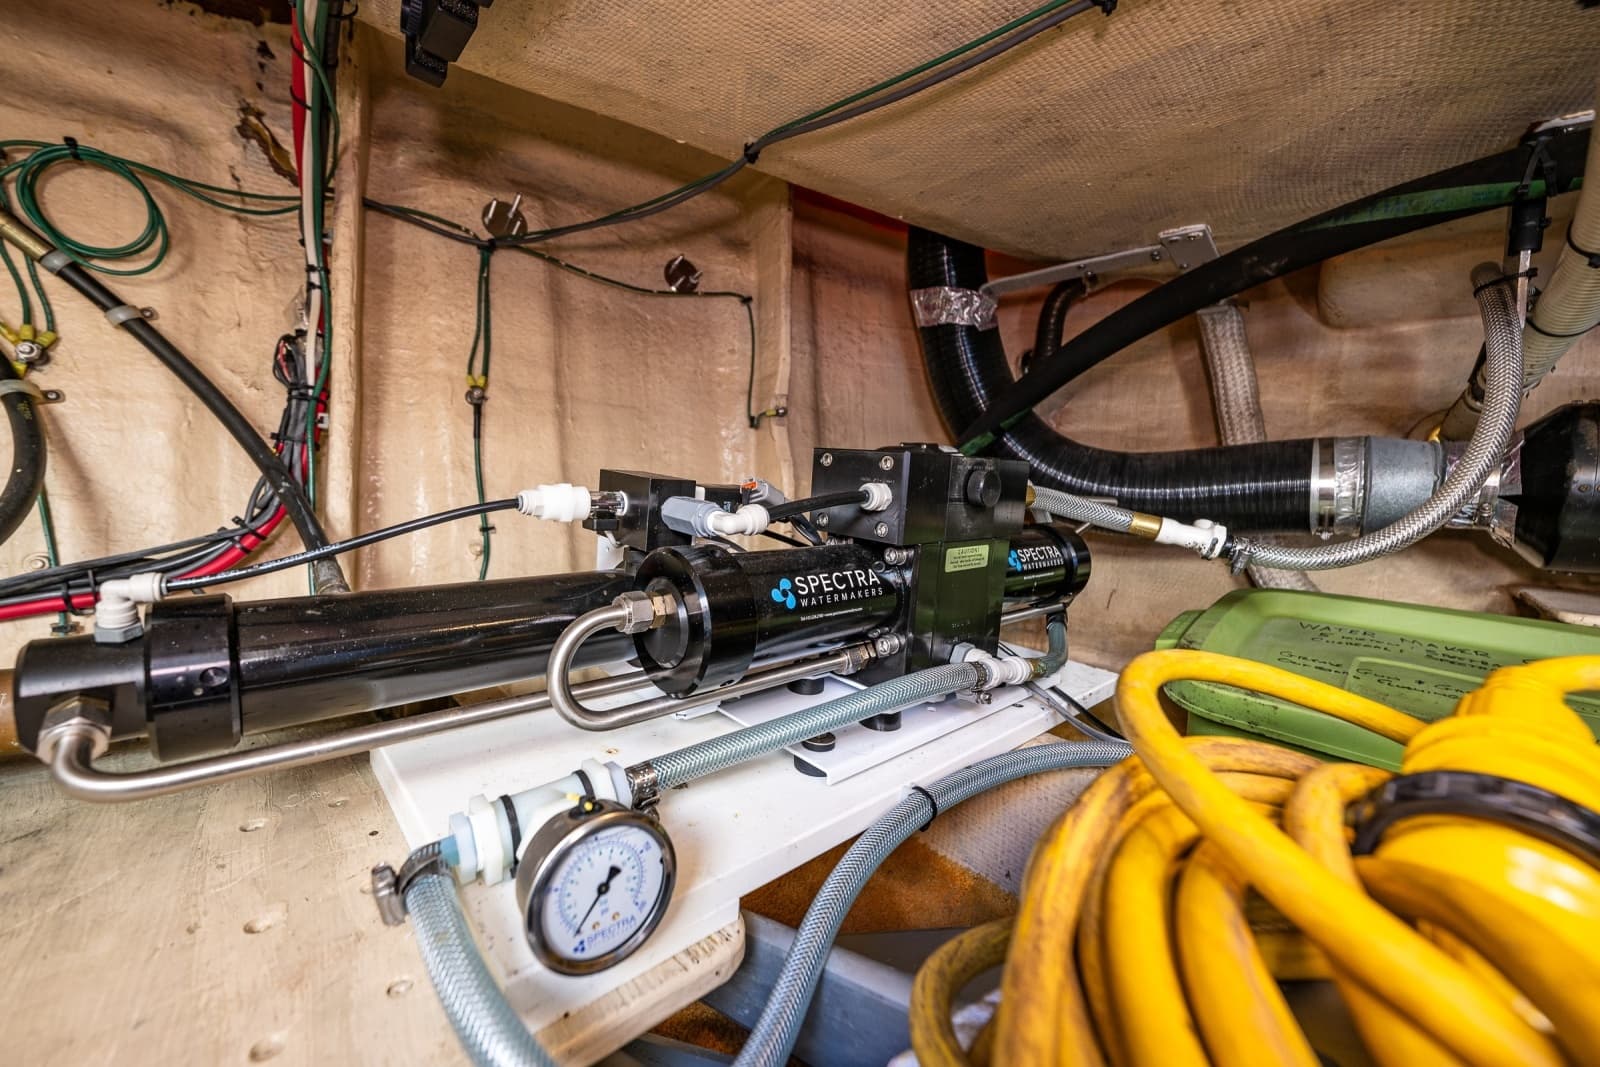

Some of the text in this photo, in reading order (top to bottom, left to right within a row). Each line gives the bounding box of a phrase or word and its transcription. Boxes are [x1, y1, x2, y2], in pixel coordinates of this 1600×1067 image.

[1017, 545, 1062, 562] SPECTRA
[1023, 558, 1065, 571] WATERMAKERS
[794, 568, 881, 595] SPECTRA
[800, 586, 884, 608] WATERMAKERS
[1299, 621, 1377, 638] WATER
